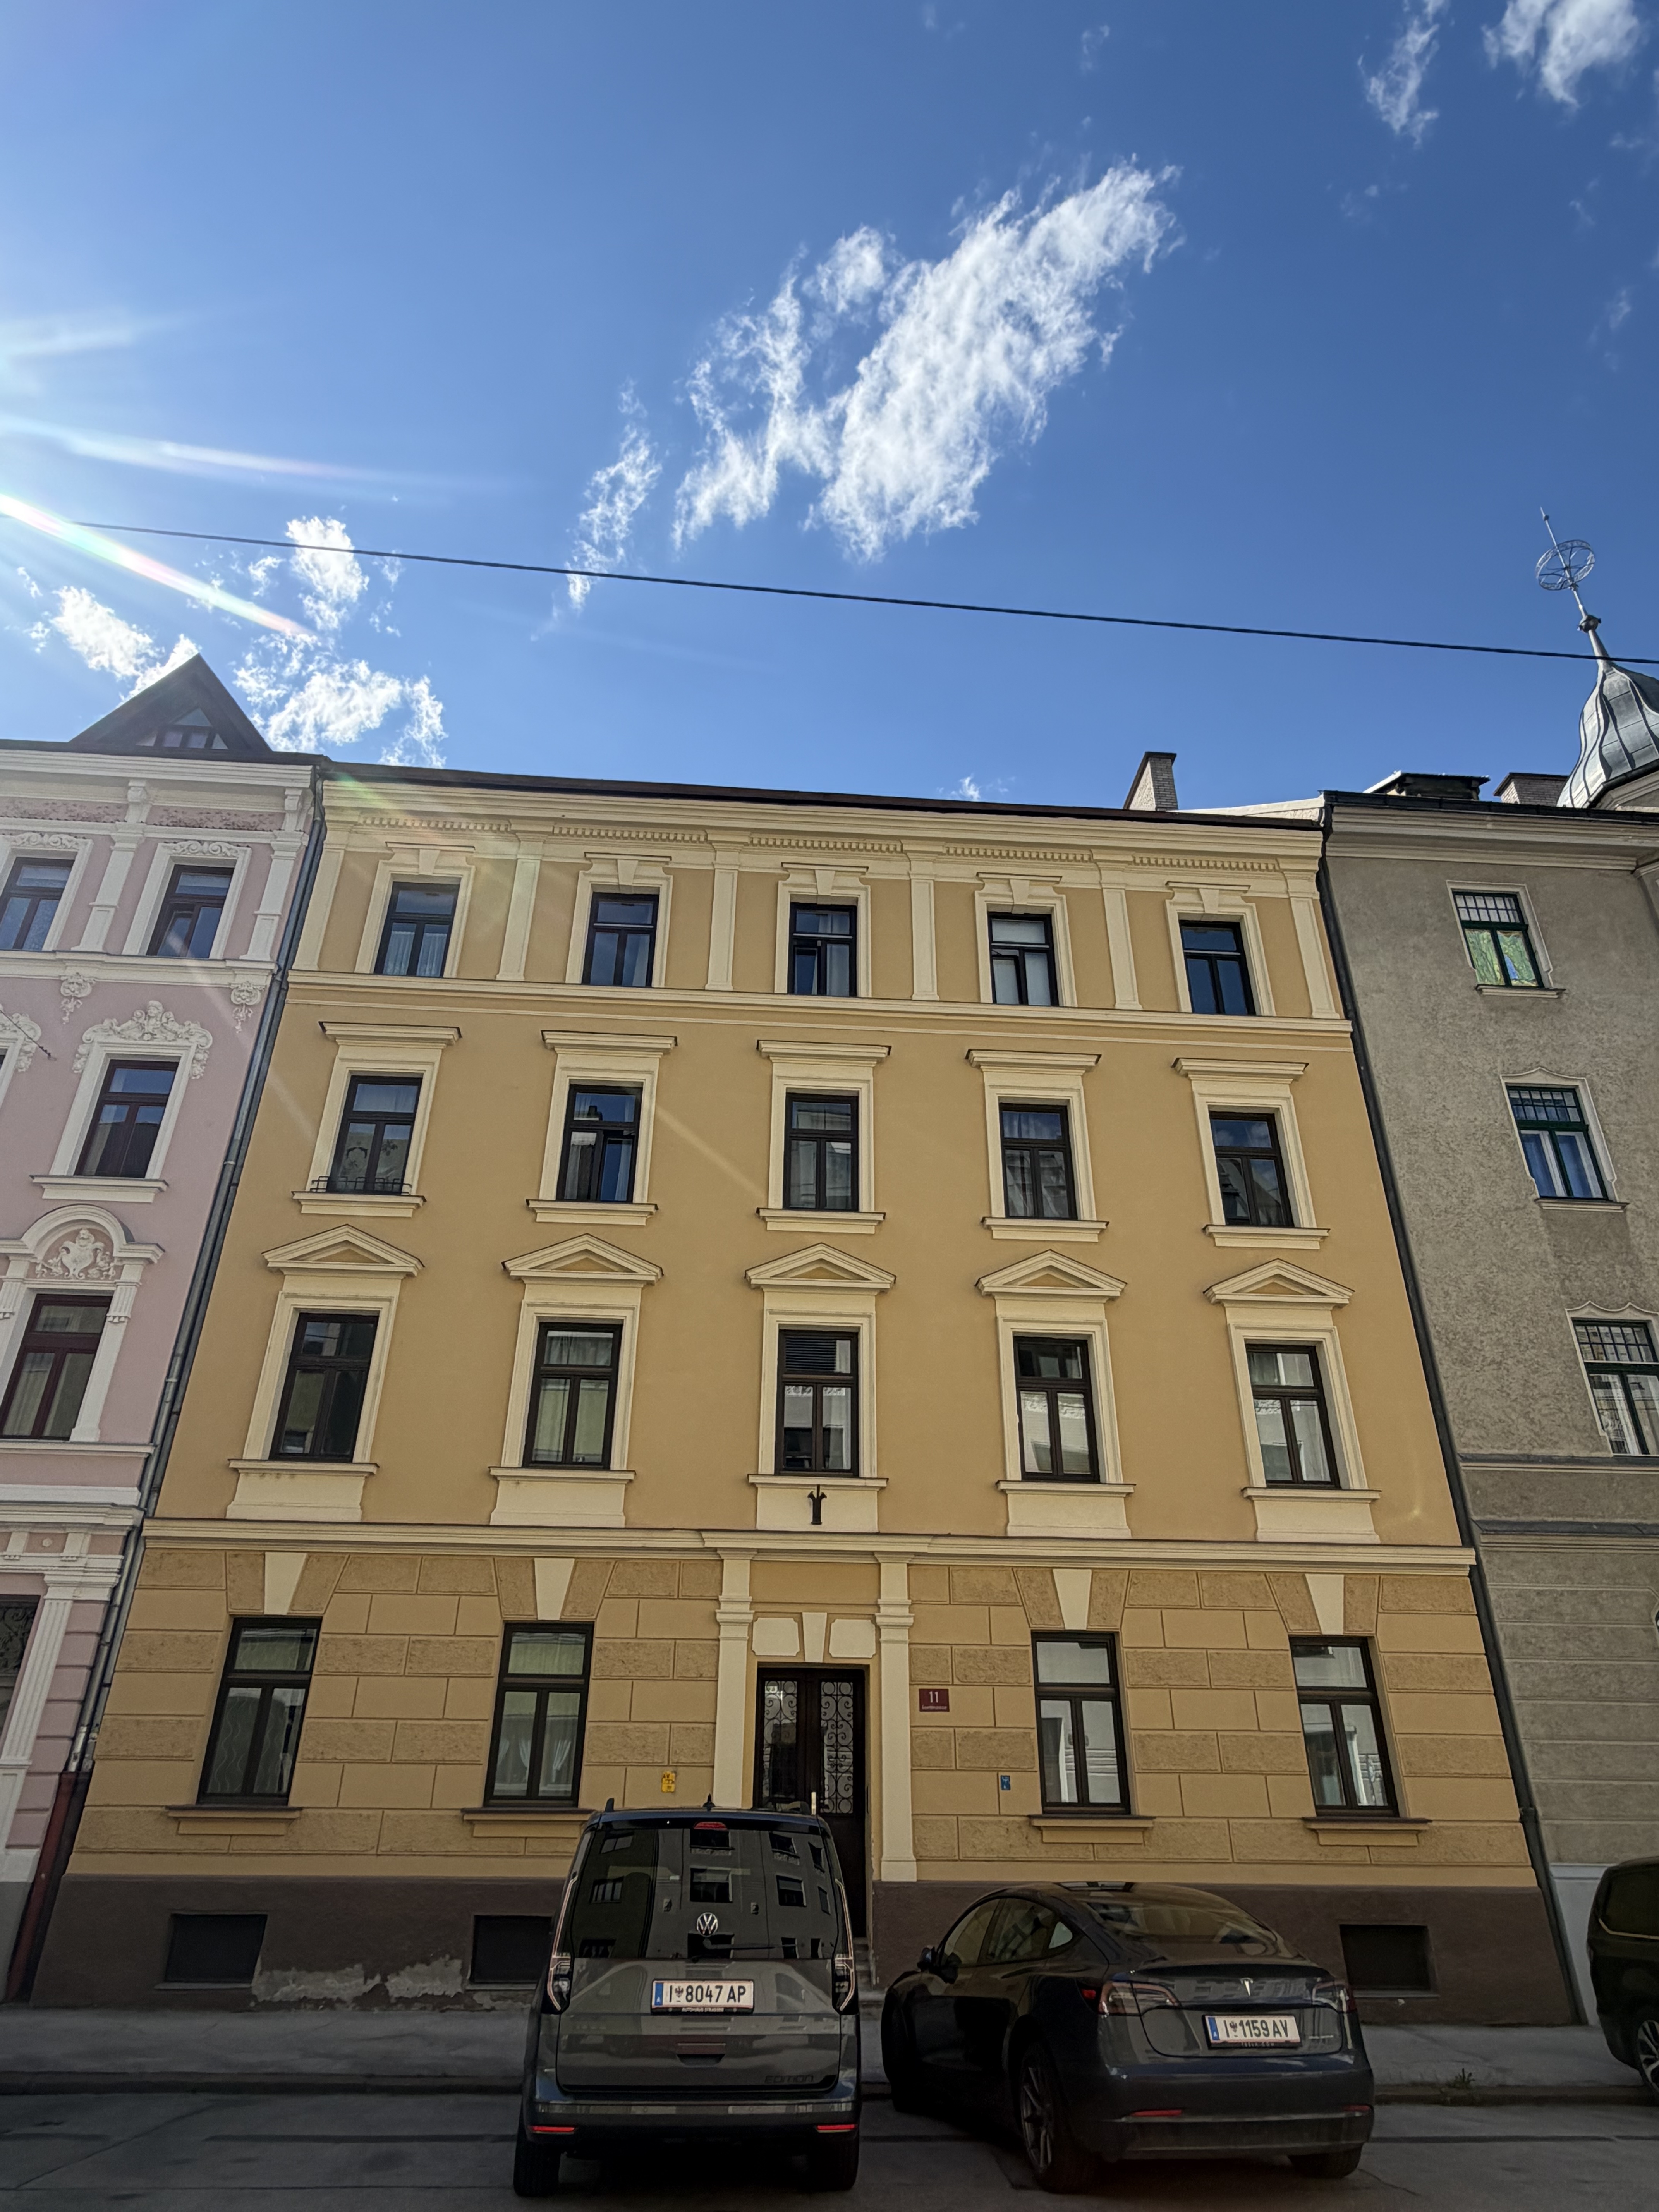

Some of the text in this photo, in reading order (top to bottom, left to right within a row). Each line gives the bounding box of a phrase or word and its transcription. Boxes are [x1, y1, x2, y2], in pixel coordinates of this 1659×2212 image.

[929, 1691, 939, 1703] 11
[669, 1985, 746, 2003] I 8047 AP
[1224, 2019, 1288, 2038] I 1159 AV
[764, 2074, 814, 2083] EDITION
